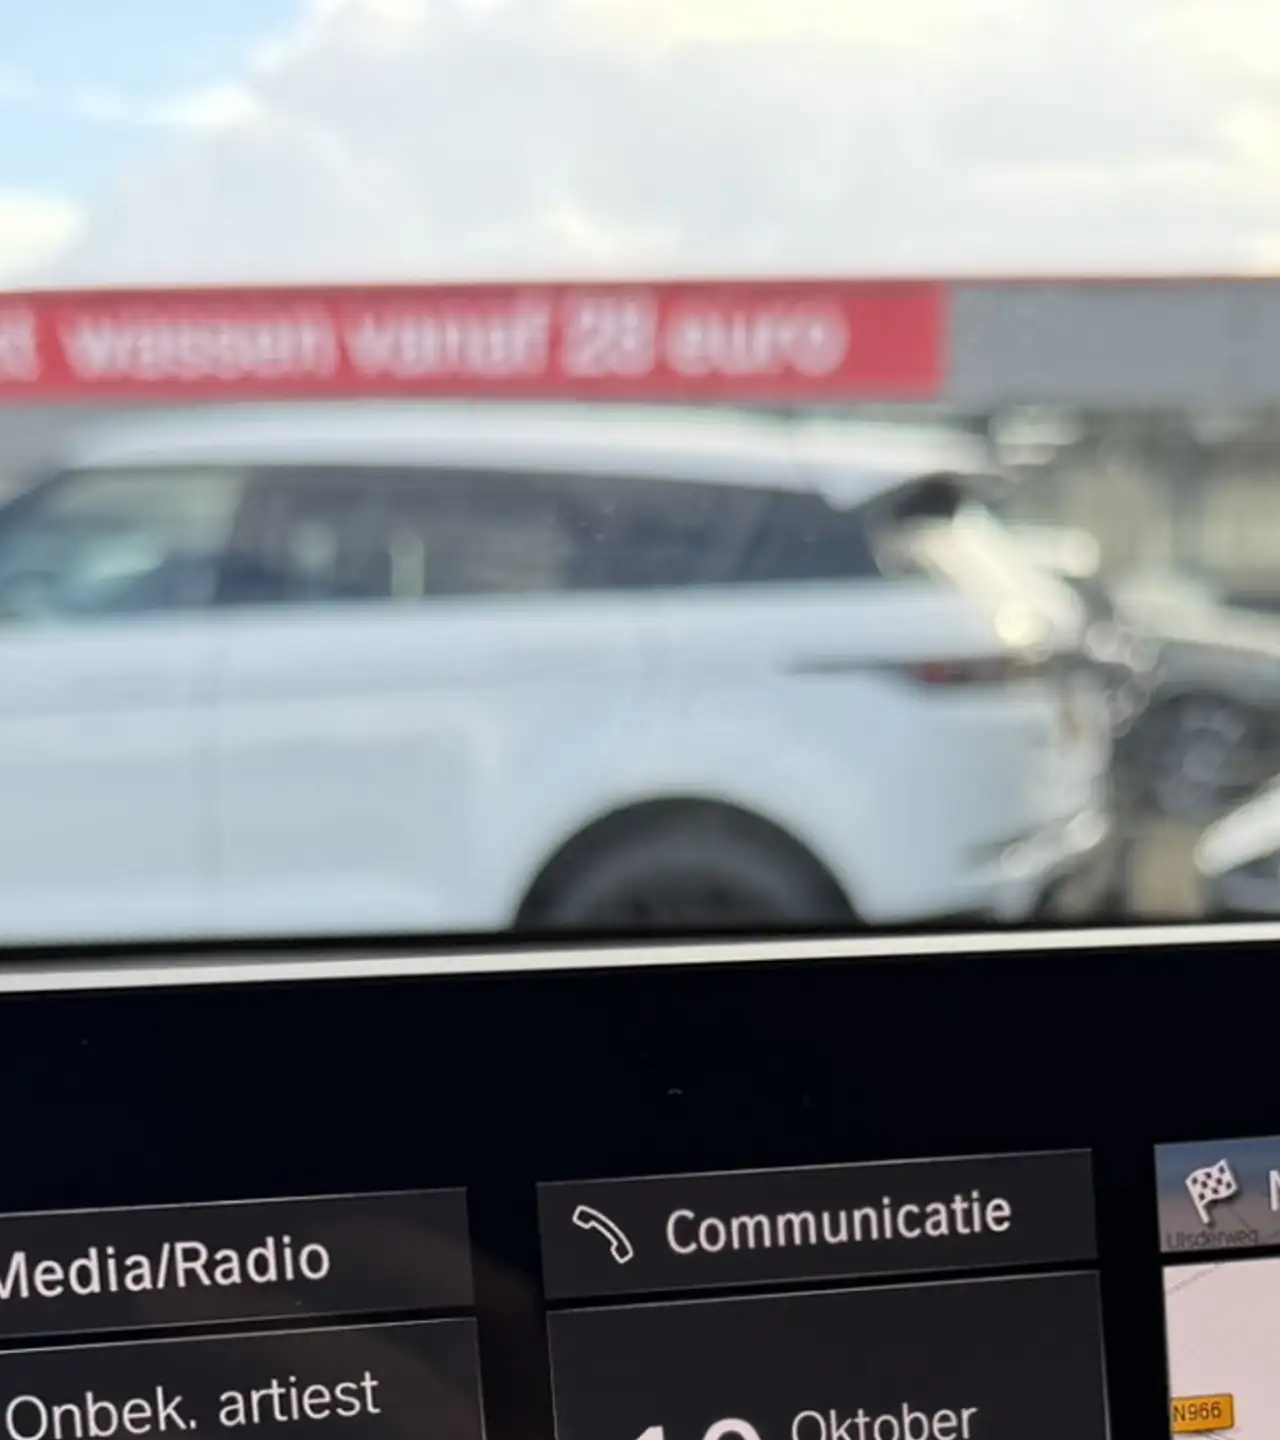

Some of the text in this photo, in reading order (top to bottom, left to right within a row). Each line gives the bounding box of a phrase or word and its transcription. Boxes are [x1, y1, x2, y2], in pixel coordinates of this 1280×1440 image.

[664, 306, 848, 380] euro
[665, 1189, 1013, 1256] Communicatie
[218, 1370, 381, 1426] artiest
[1172, 1400, 1222, 1423] N966
